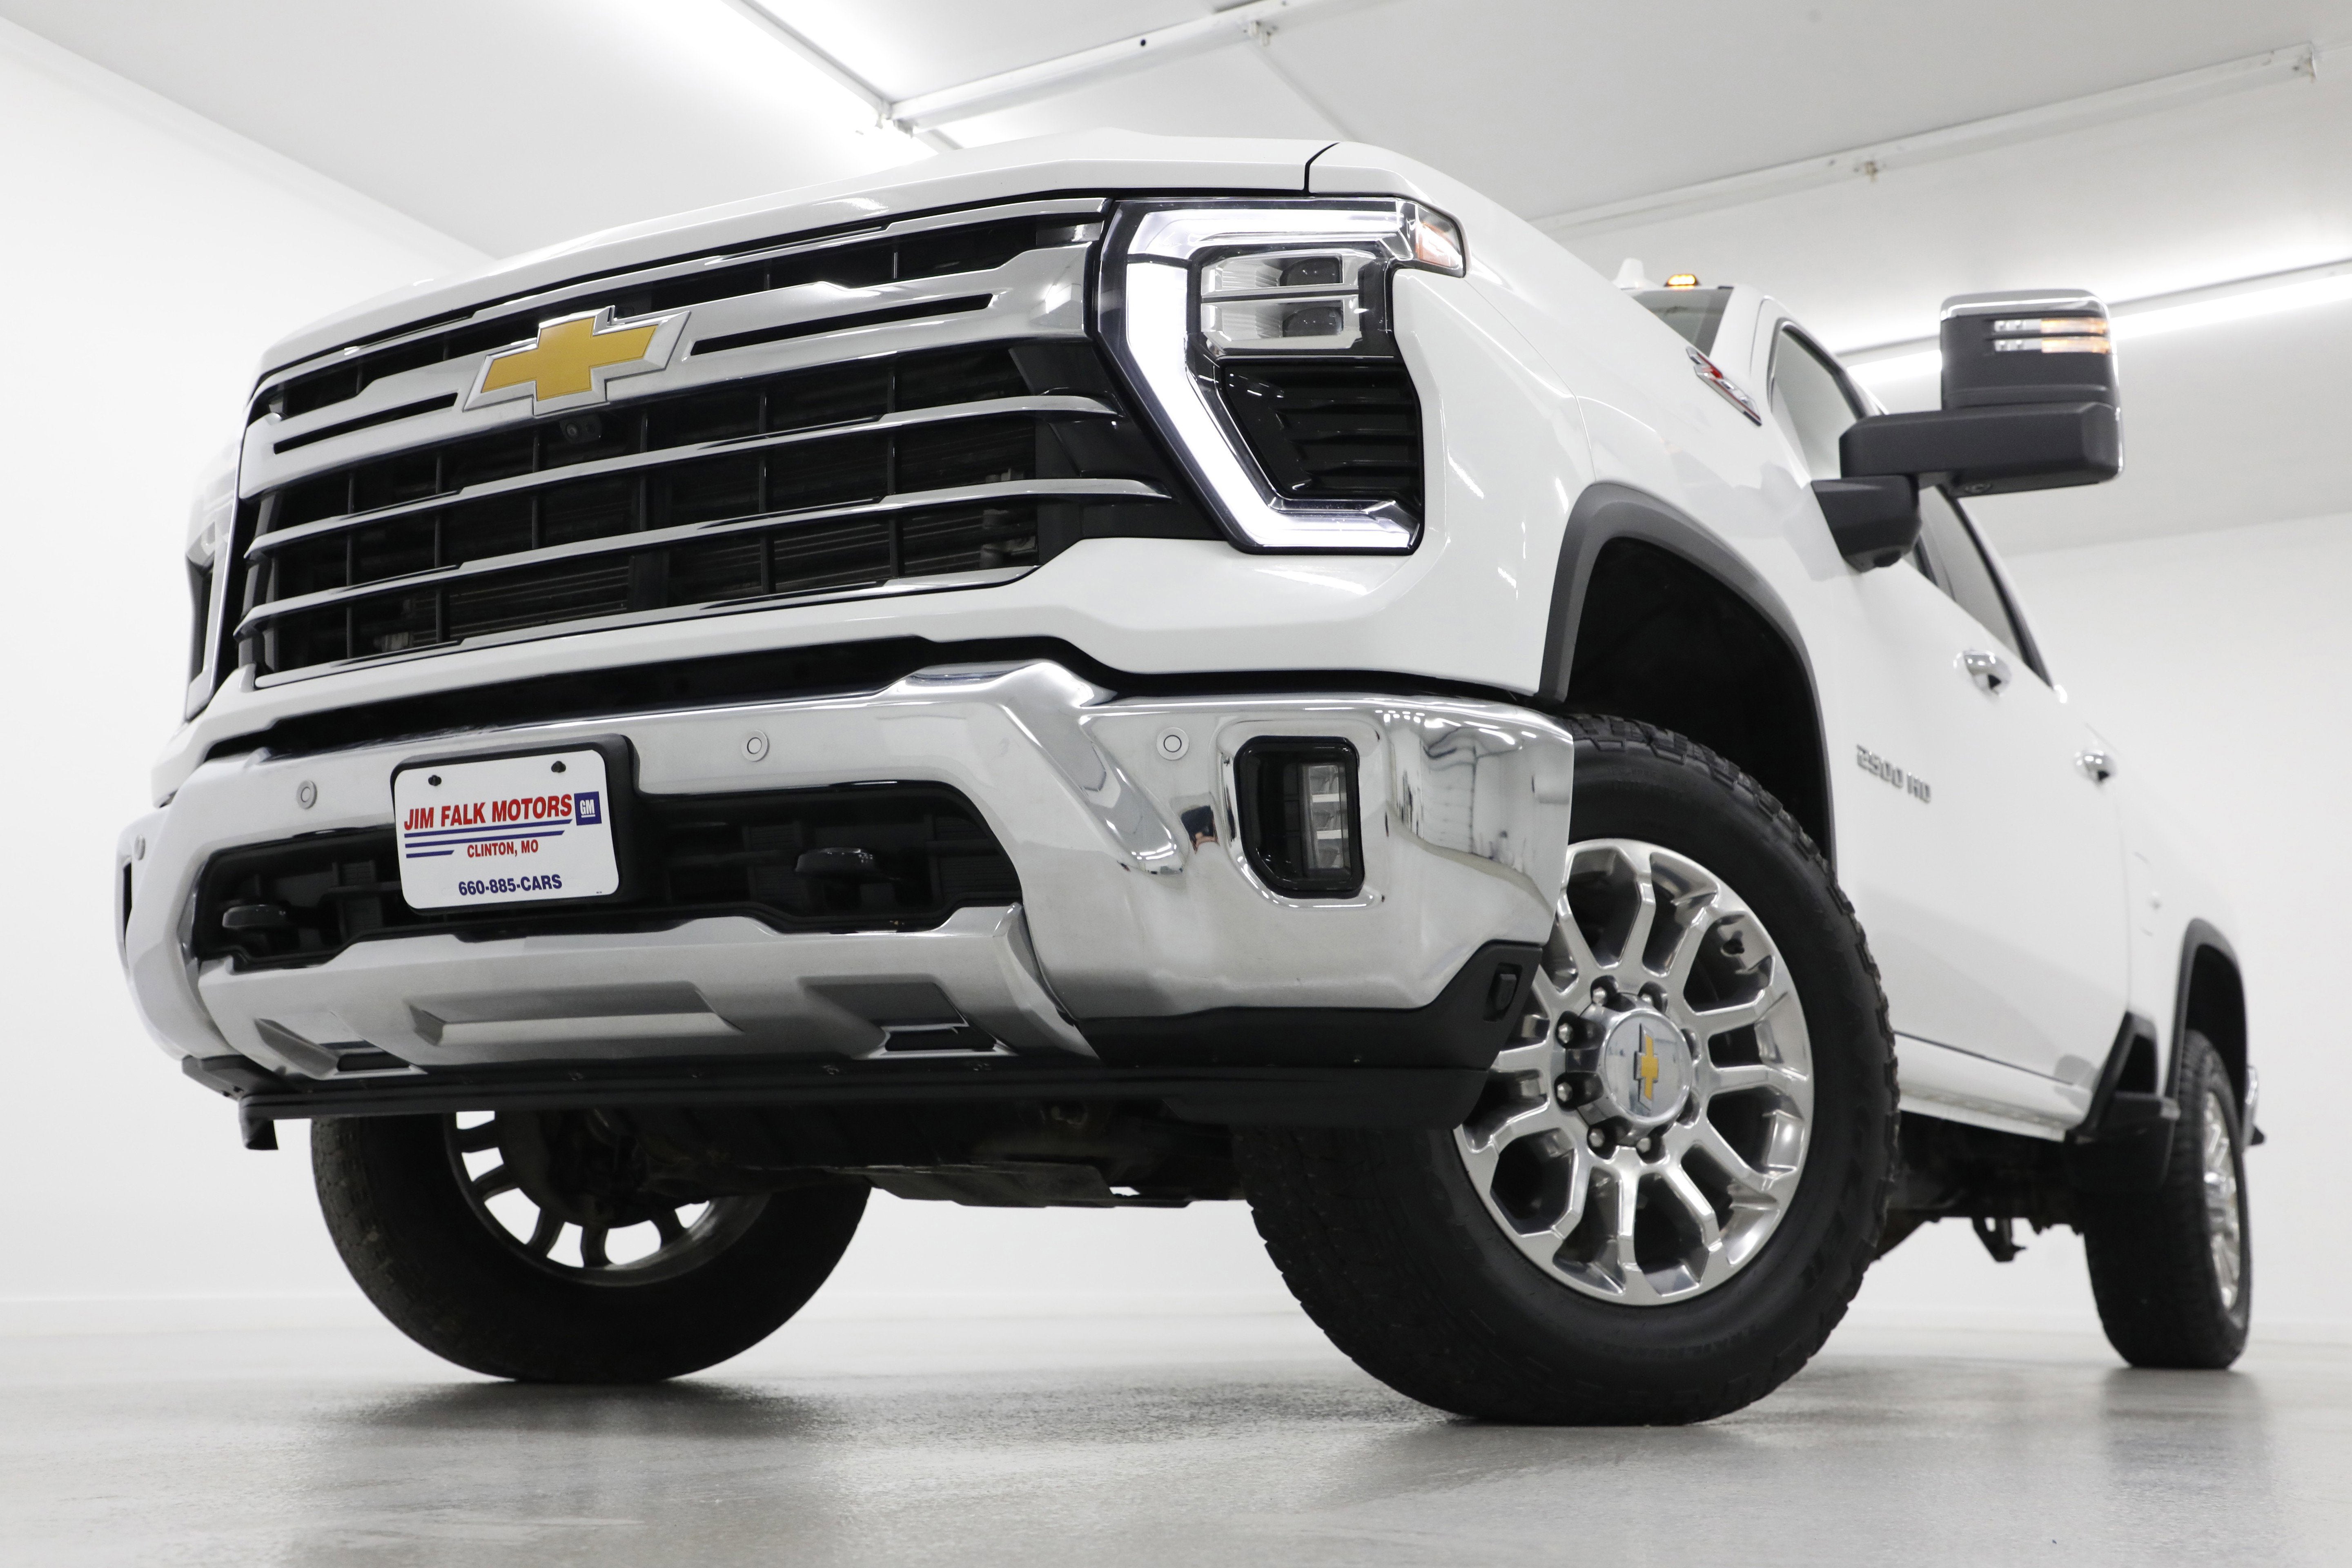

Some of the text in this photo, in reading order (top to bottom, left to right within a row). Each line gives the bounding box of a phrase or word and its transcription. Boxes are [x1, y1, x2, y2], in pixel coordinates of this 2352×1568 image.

[404, 793, 572, 831] JIM FALK MOTORS
[580, 799, 595, 815] GM
[467, 839, 539, 858] CLINTON, MO
[459, 874, 562, 896] 660-885-CARS
